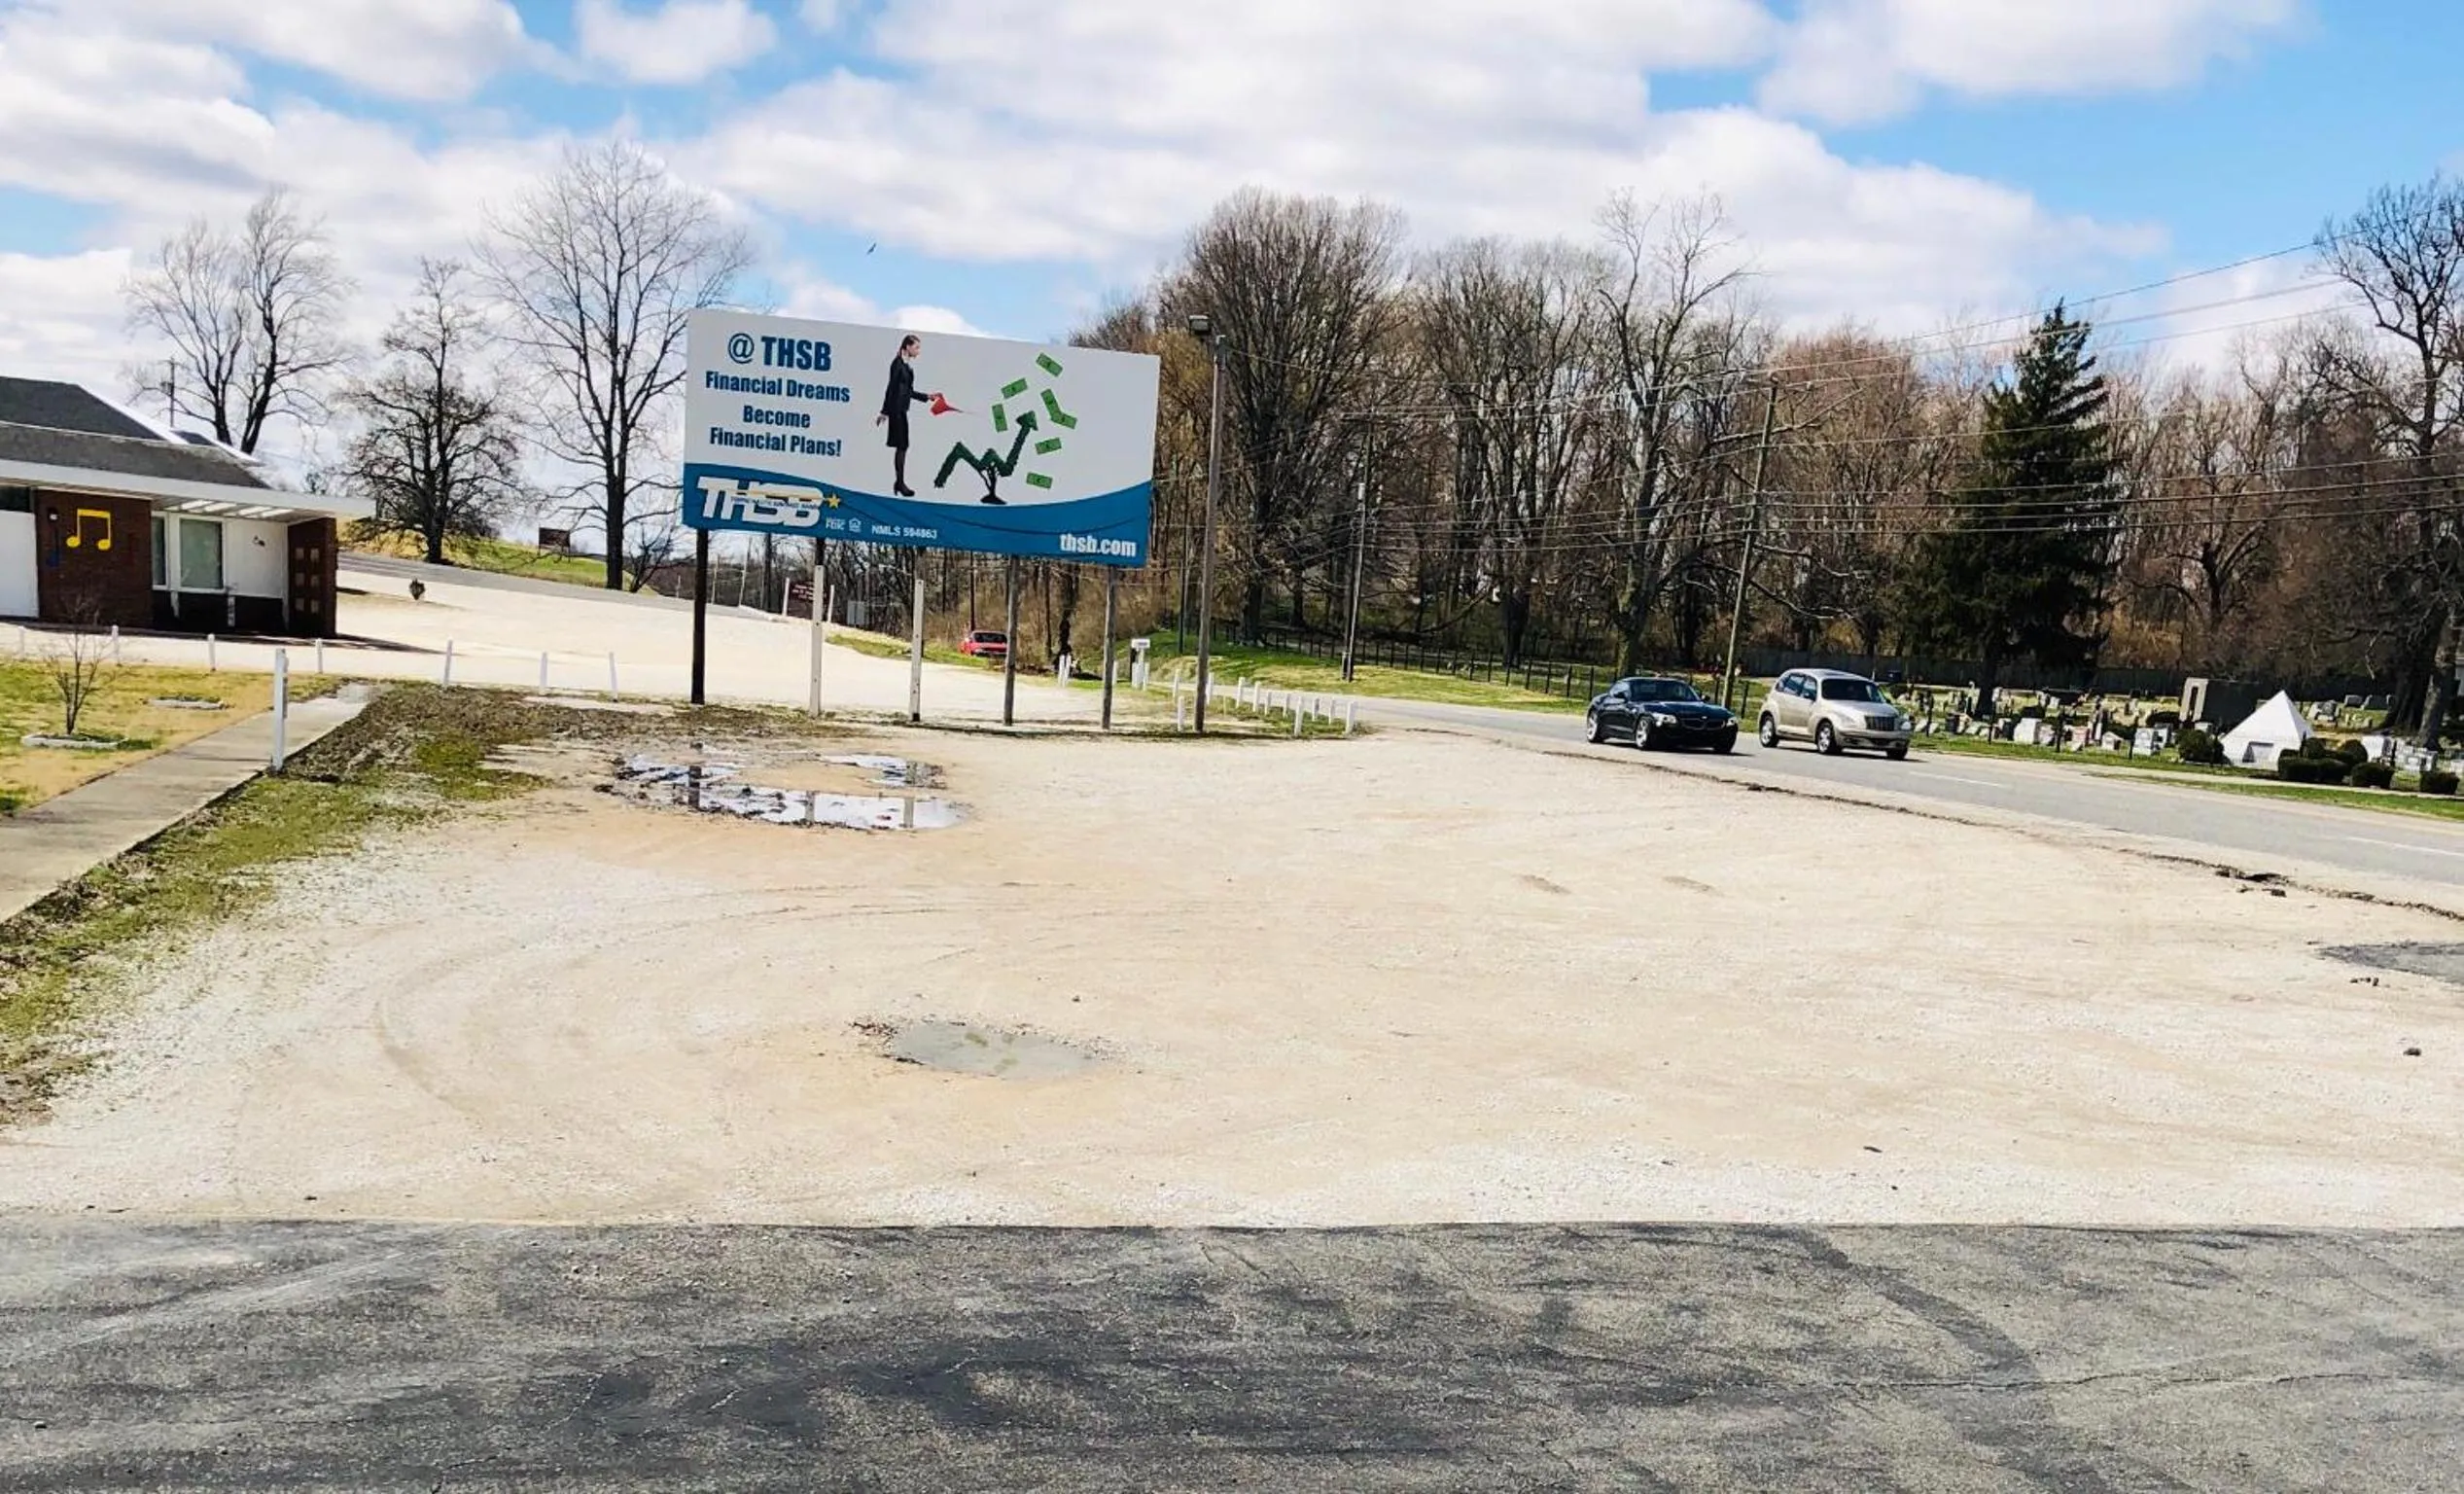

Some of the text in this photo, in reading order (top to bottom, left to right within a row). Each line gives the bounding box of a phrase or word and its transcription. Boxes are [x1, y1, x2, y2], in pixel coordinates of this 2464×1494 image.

[728, 333, 831, 372] @ THSB
[706, 371, 851, 403] Financial Dreams
[743, 405, 811, 428] Become
[710, 427, 842, 457] Financial Plans!
[697, 476, 824, 527] THSB
[871, 525, 900, 537] NMLS
[1060, 533, 1137, 557] thsb.com
